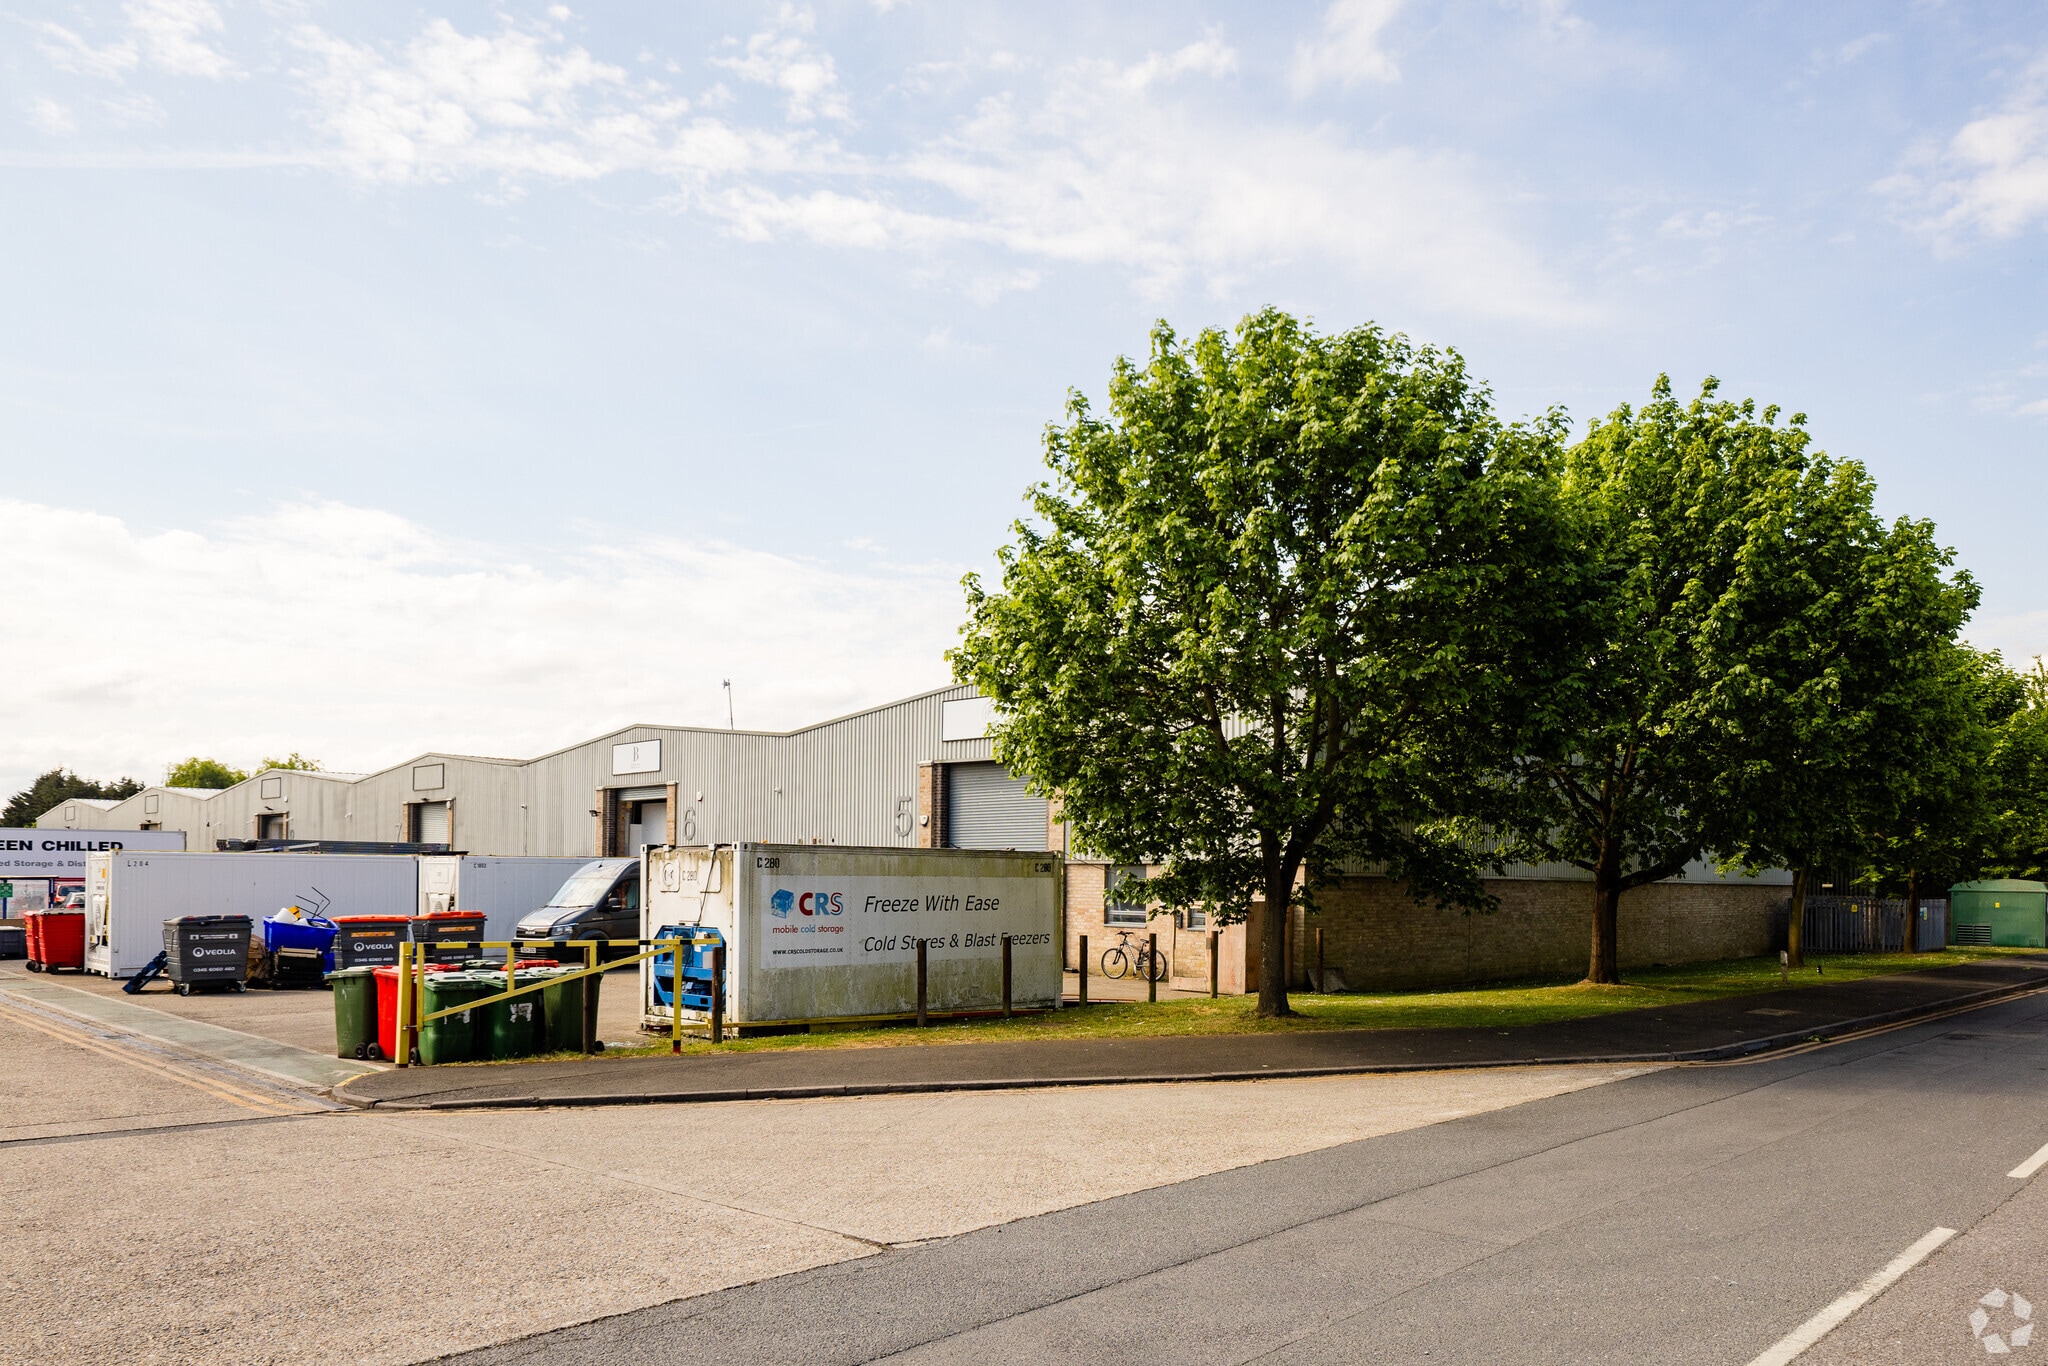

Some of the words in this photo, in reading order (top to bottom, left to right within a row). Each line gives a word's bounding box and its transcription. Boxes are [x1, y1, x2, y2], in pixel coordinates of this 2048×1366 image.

[895, 796, 912, 837] 5
[684, 807, 696, 841] 6
[0, 840, 33, 851] EEN
[41, 840, 123, 851] CHILLED
[13, 860, 54, 868] Storage
[757, 857, 763, 868] C
[764, 857, 780, 869] 280
[1034, 862, 1039, 873] C
[1039, 862, 1051, 873] 280
[798, 892, 844, 916] CRS
[864, 895, 919, 913] Freeze
[925, 895, 959, 912] With
[965, 895, 1000, 911] Ease
[772, 924, 799, 934] mobile
[800, 924, 816, 934] cold
[817, 925, 844, 935] storage
[864, 936, 896, 951] Cold
[949, 933, 959, 948] &
[964, 932, 997, 948] Blast
[772, 947, 844, 955] WWW.CRSCOLDSTORAGE.CO.UK
